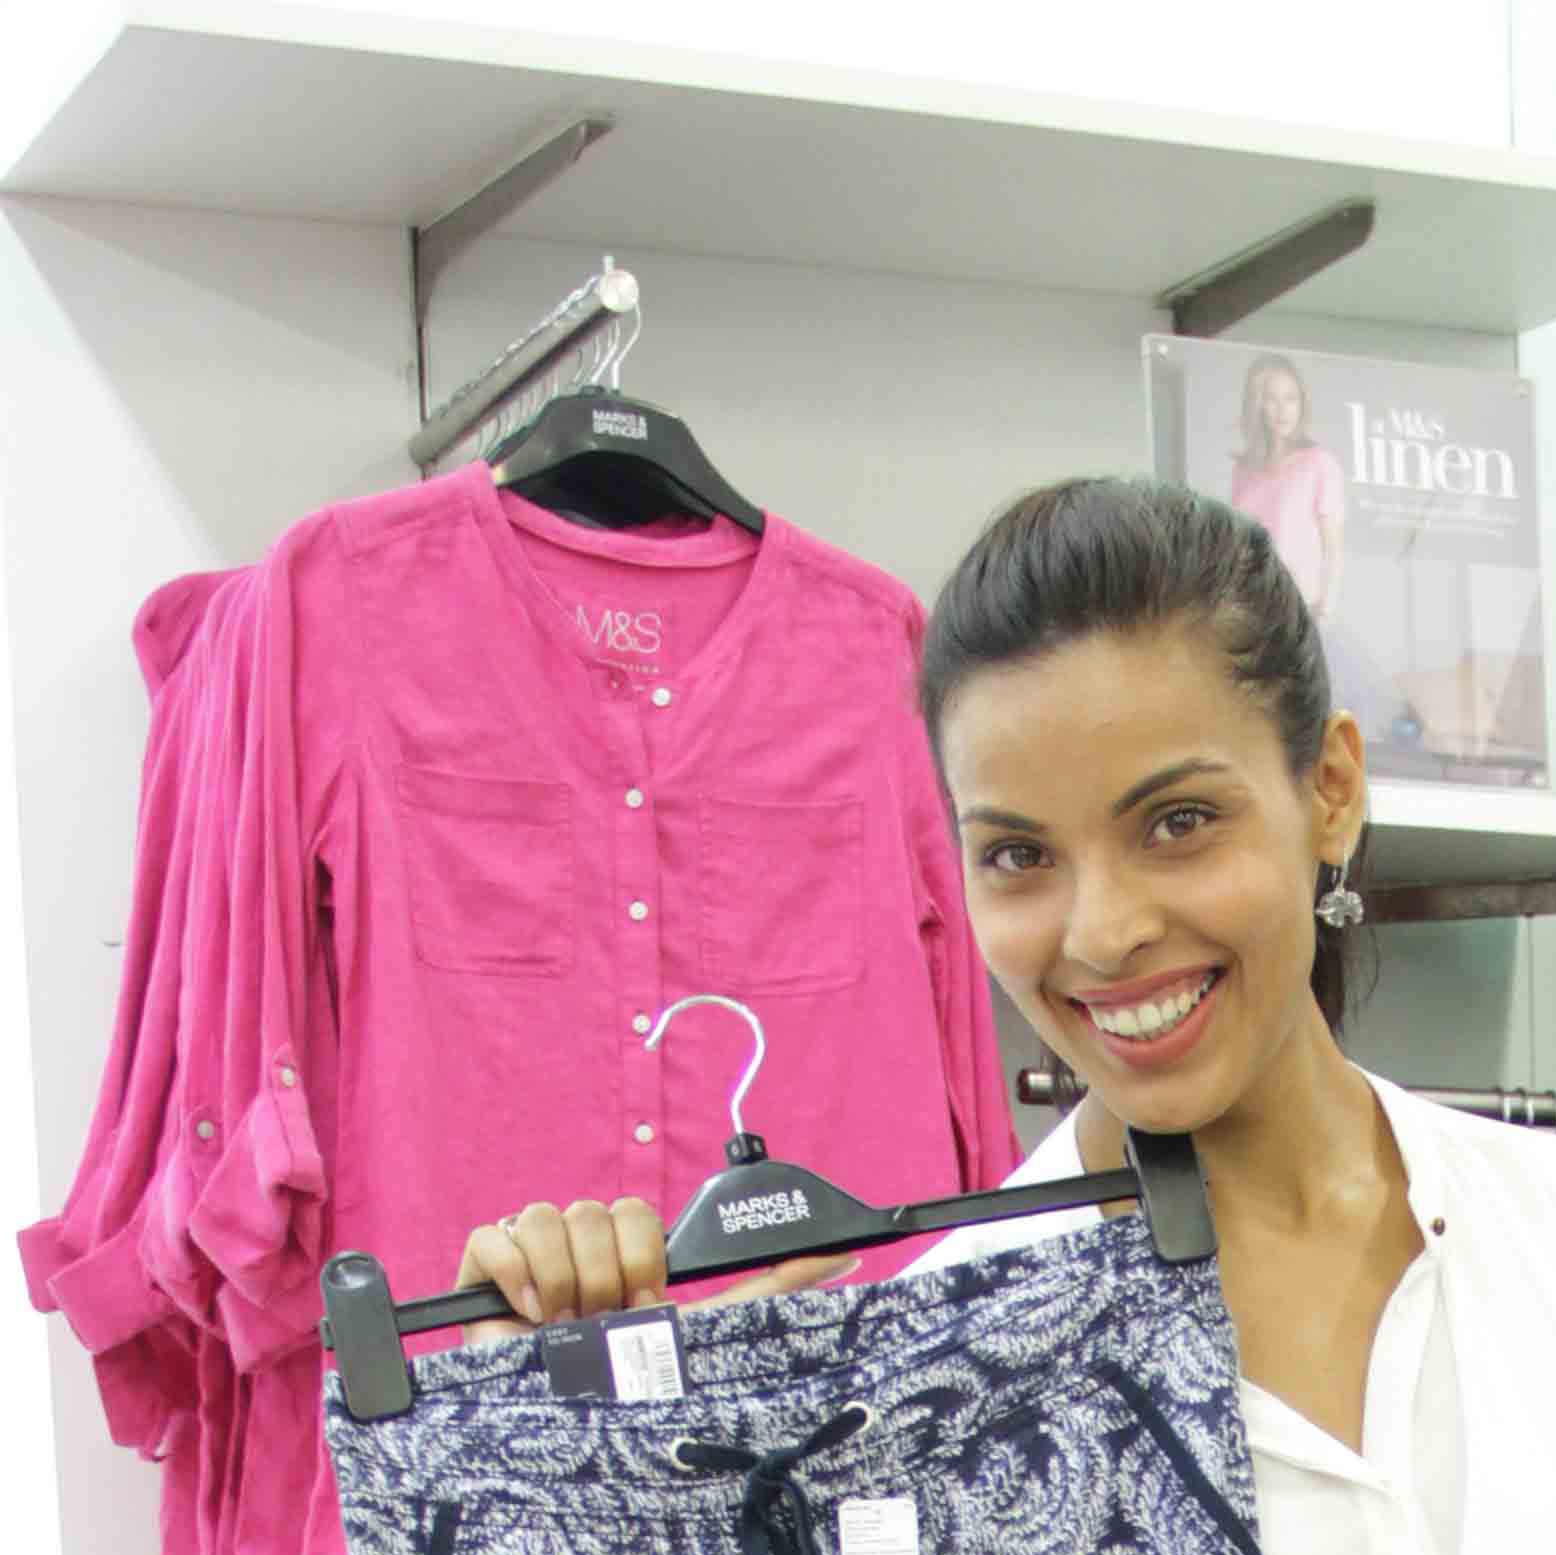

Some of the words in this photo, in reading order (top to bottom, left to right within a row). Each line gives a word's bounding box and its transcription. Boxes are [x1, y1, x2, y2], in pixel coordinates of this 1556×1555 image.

[1344, 401, 1519, 499] linen
[576, 604, 662, 654] M&S
[717, 1191, 789, 1218] MARKS
[791, 1188, 808, 1206] &
[722, 1204, 811, 1233] SPENCER
